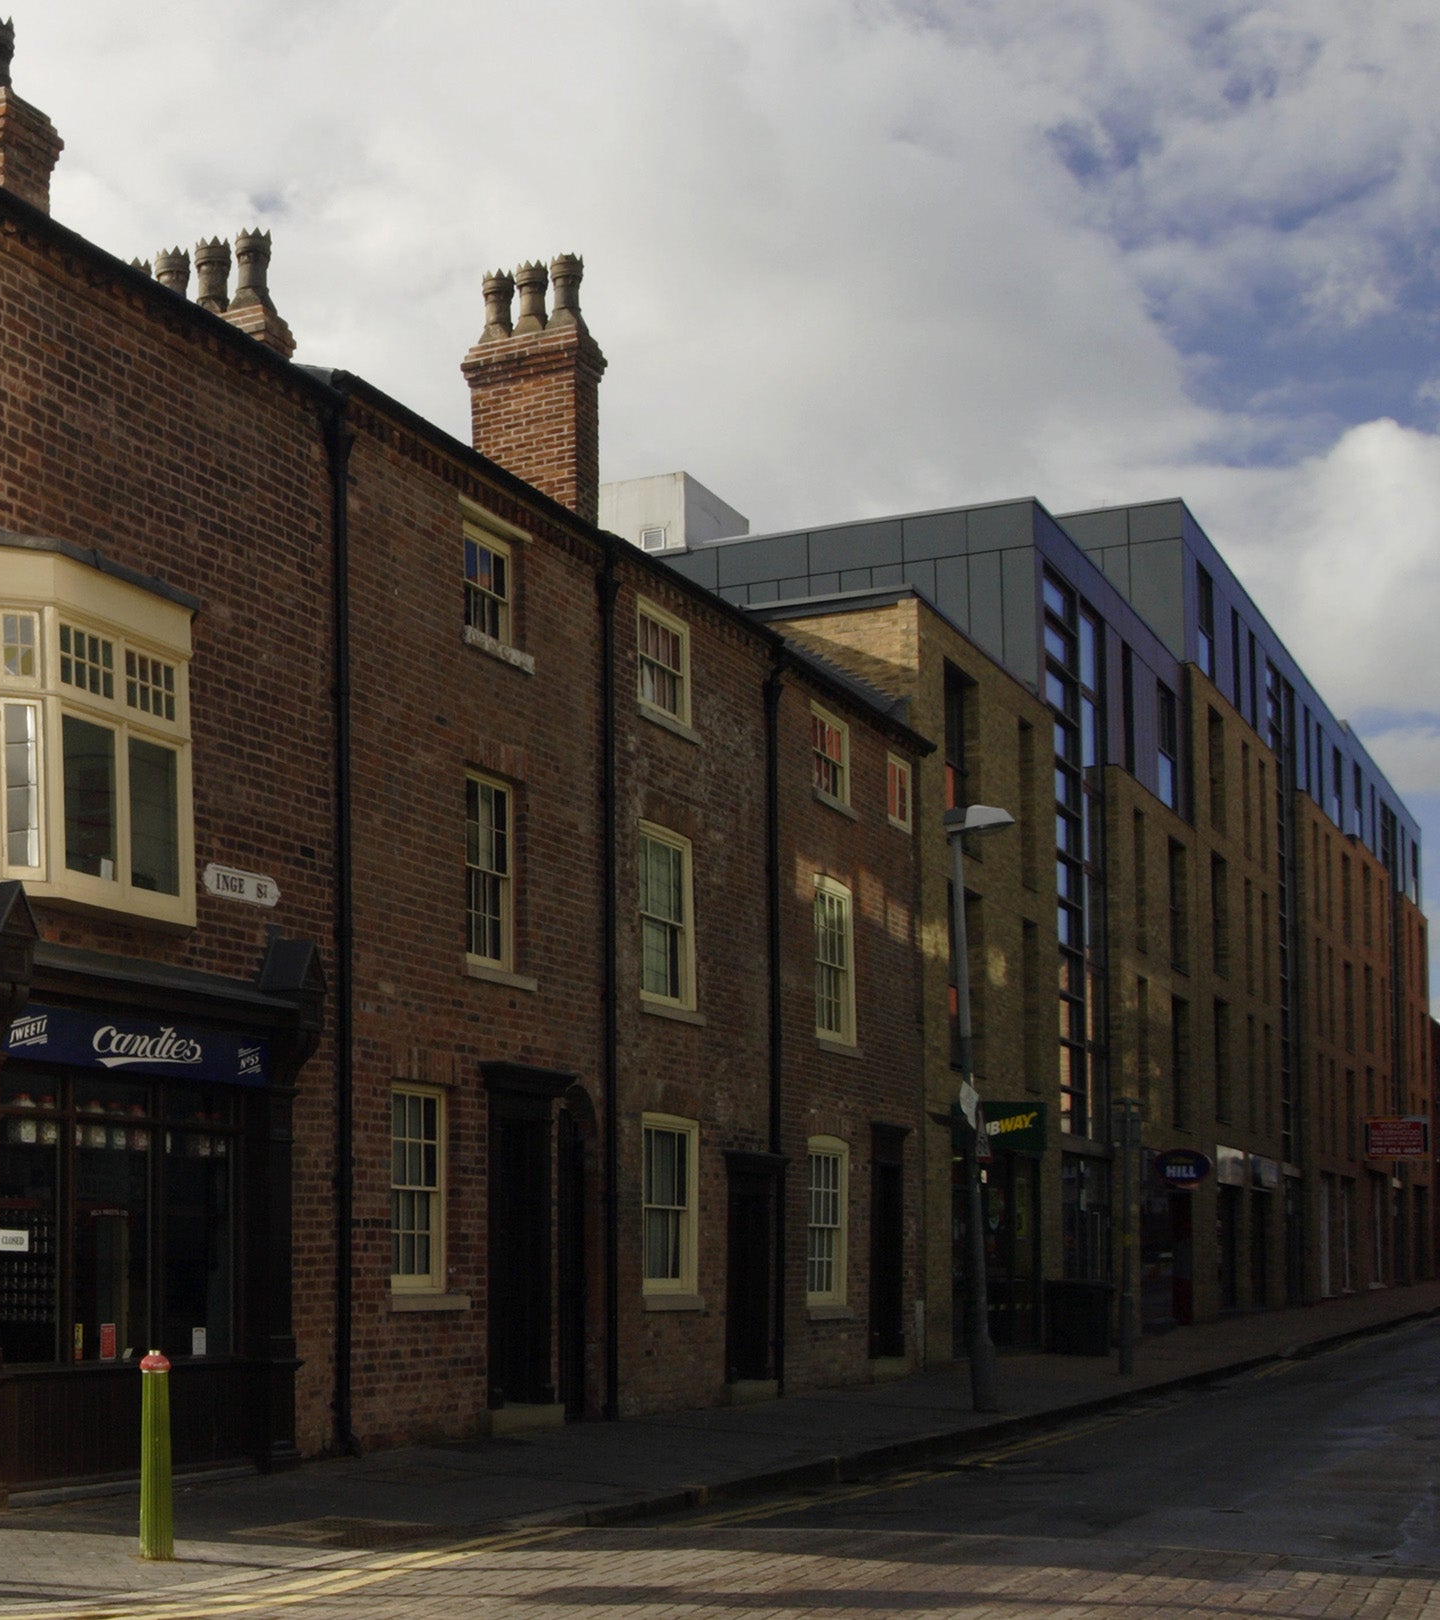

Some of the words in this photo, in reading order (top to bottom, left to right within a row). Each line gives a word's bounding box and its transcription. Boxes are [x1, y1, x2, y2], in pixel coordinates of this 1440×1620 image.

[216, 873, 245, 894] INGE
[9, 1018, 49, 1044] SWEETS
[91, 1024, 203, 1061] Candies
[985, 1111, 1039, 1136] BWAY
[1165, 1165, 1196, 1178] HILL
[1, 1236, 25, 1245] CLOSED
